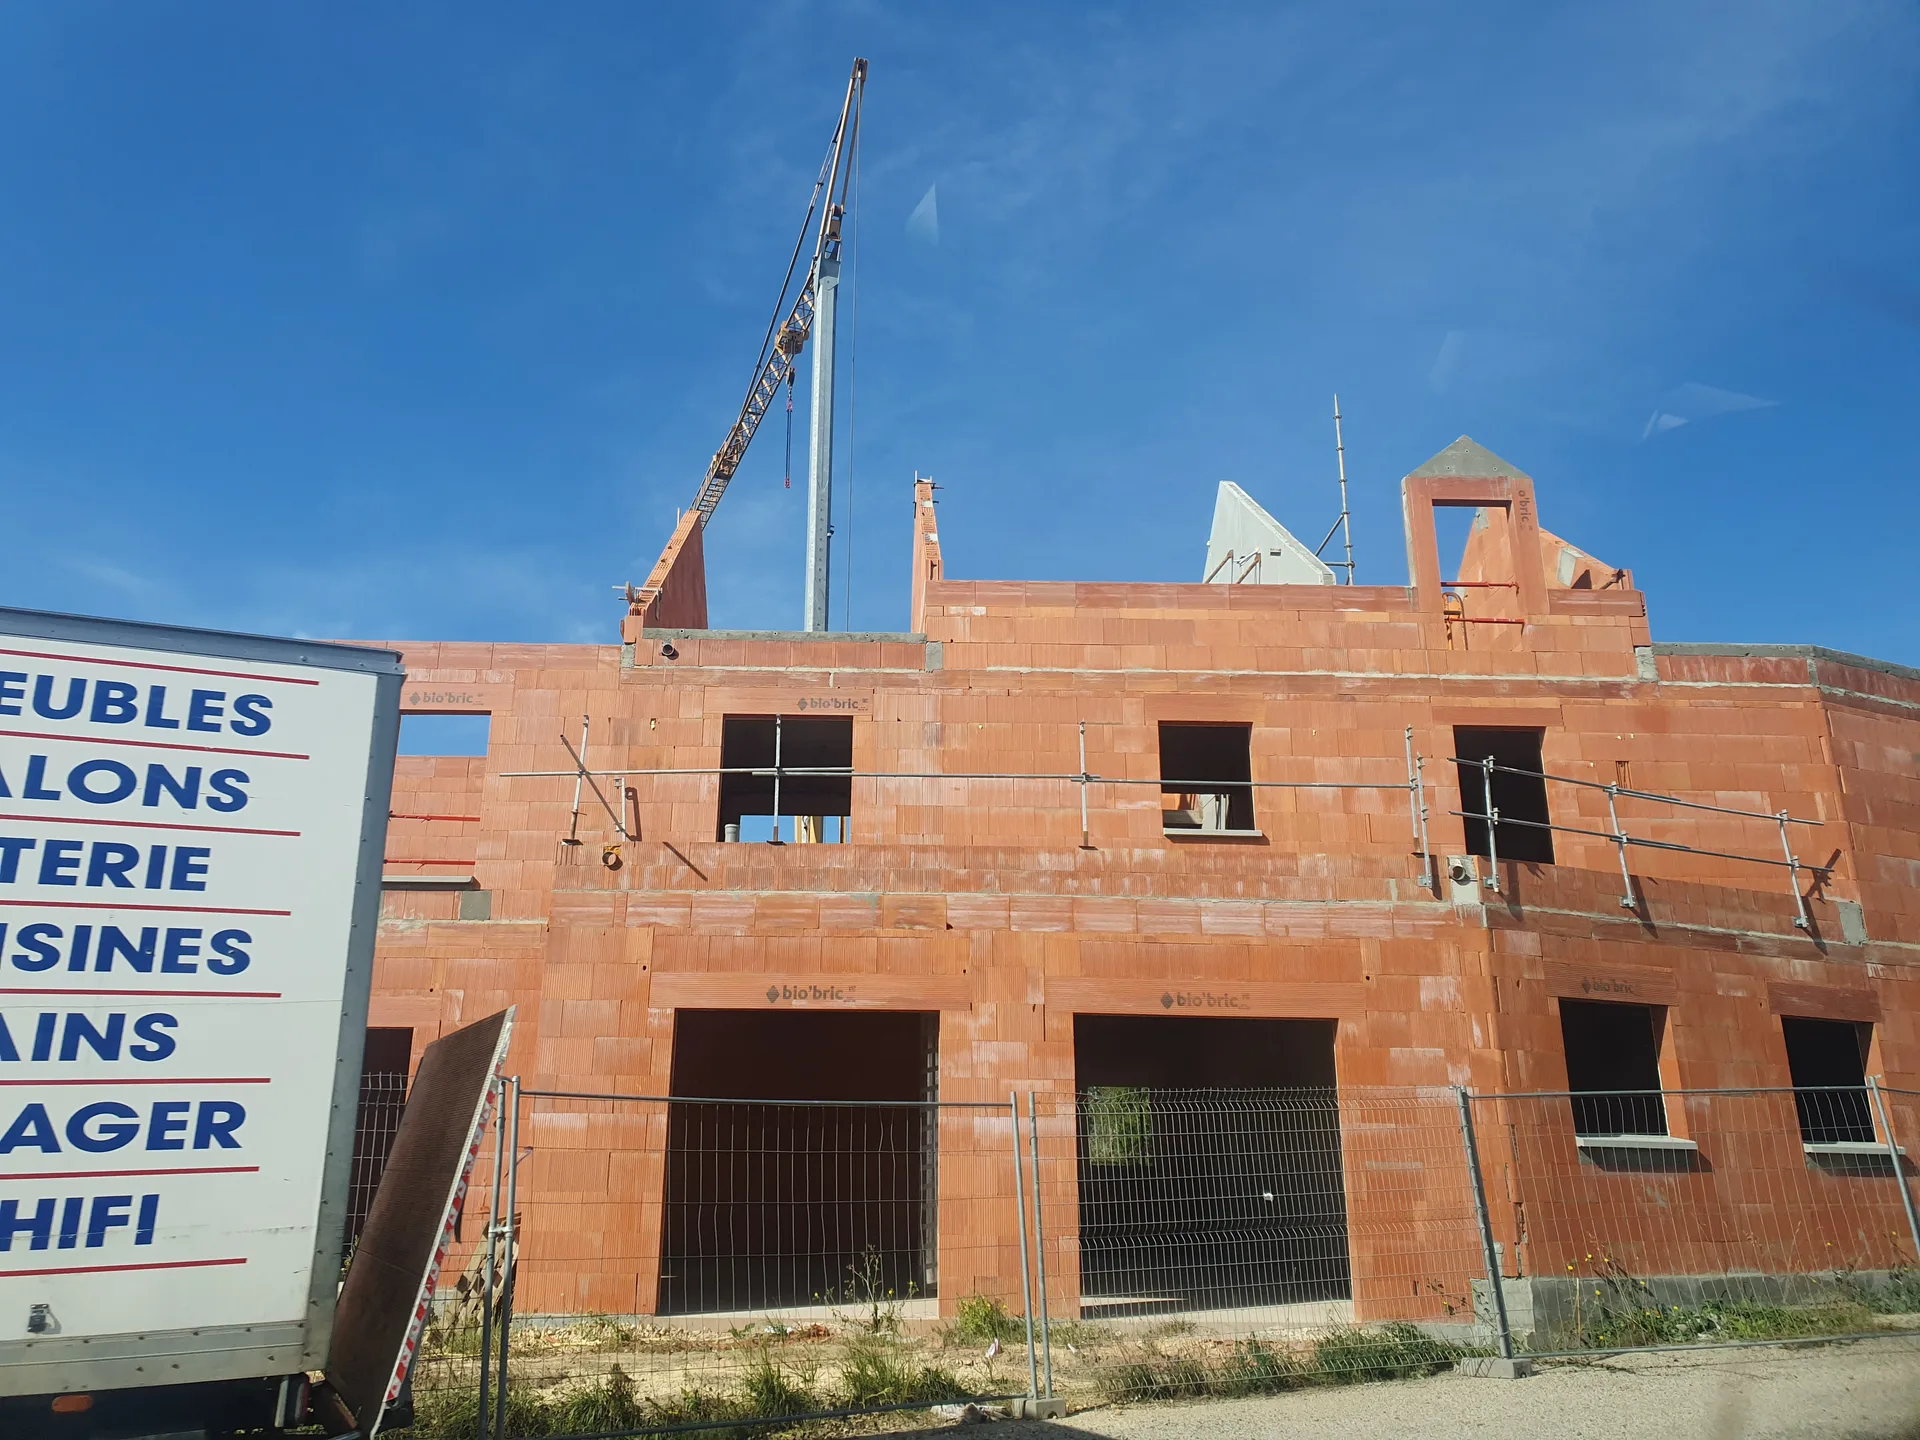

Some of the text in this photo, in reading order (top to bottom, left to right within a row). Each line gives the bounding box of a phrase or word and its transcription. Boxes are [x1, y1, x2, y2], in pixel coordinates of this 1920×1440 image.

[0, 671, 273, 736] EUBLES
[0, 755, 250, 812] LONS
[0, 837, 211, 891] TERIE
[0, 922, 252, 975] SINES
[782, 985, 844, 1000] bio'bric
[0, 1101, 246, 1154] AGER
[0, 1194, 160, 1252] HIFI
